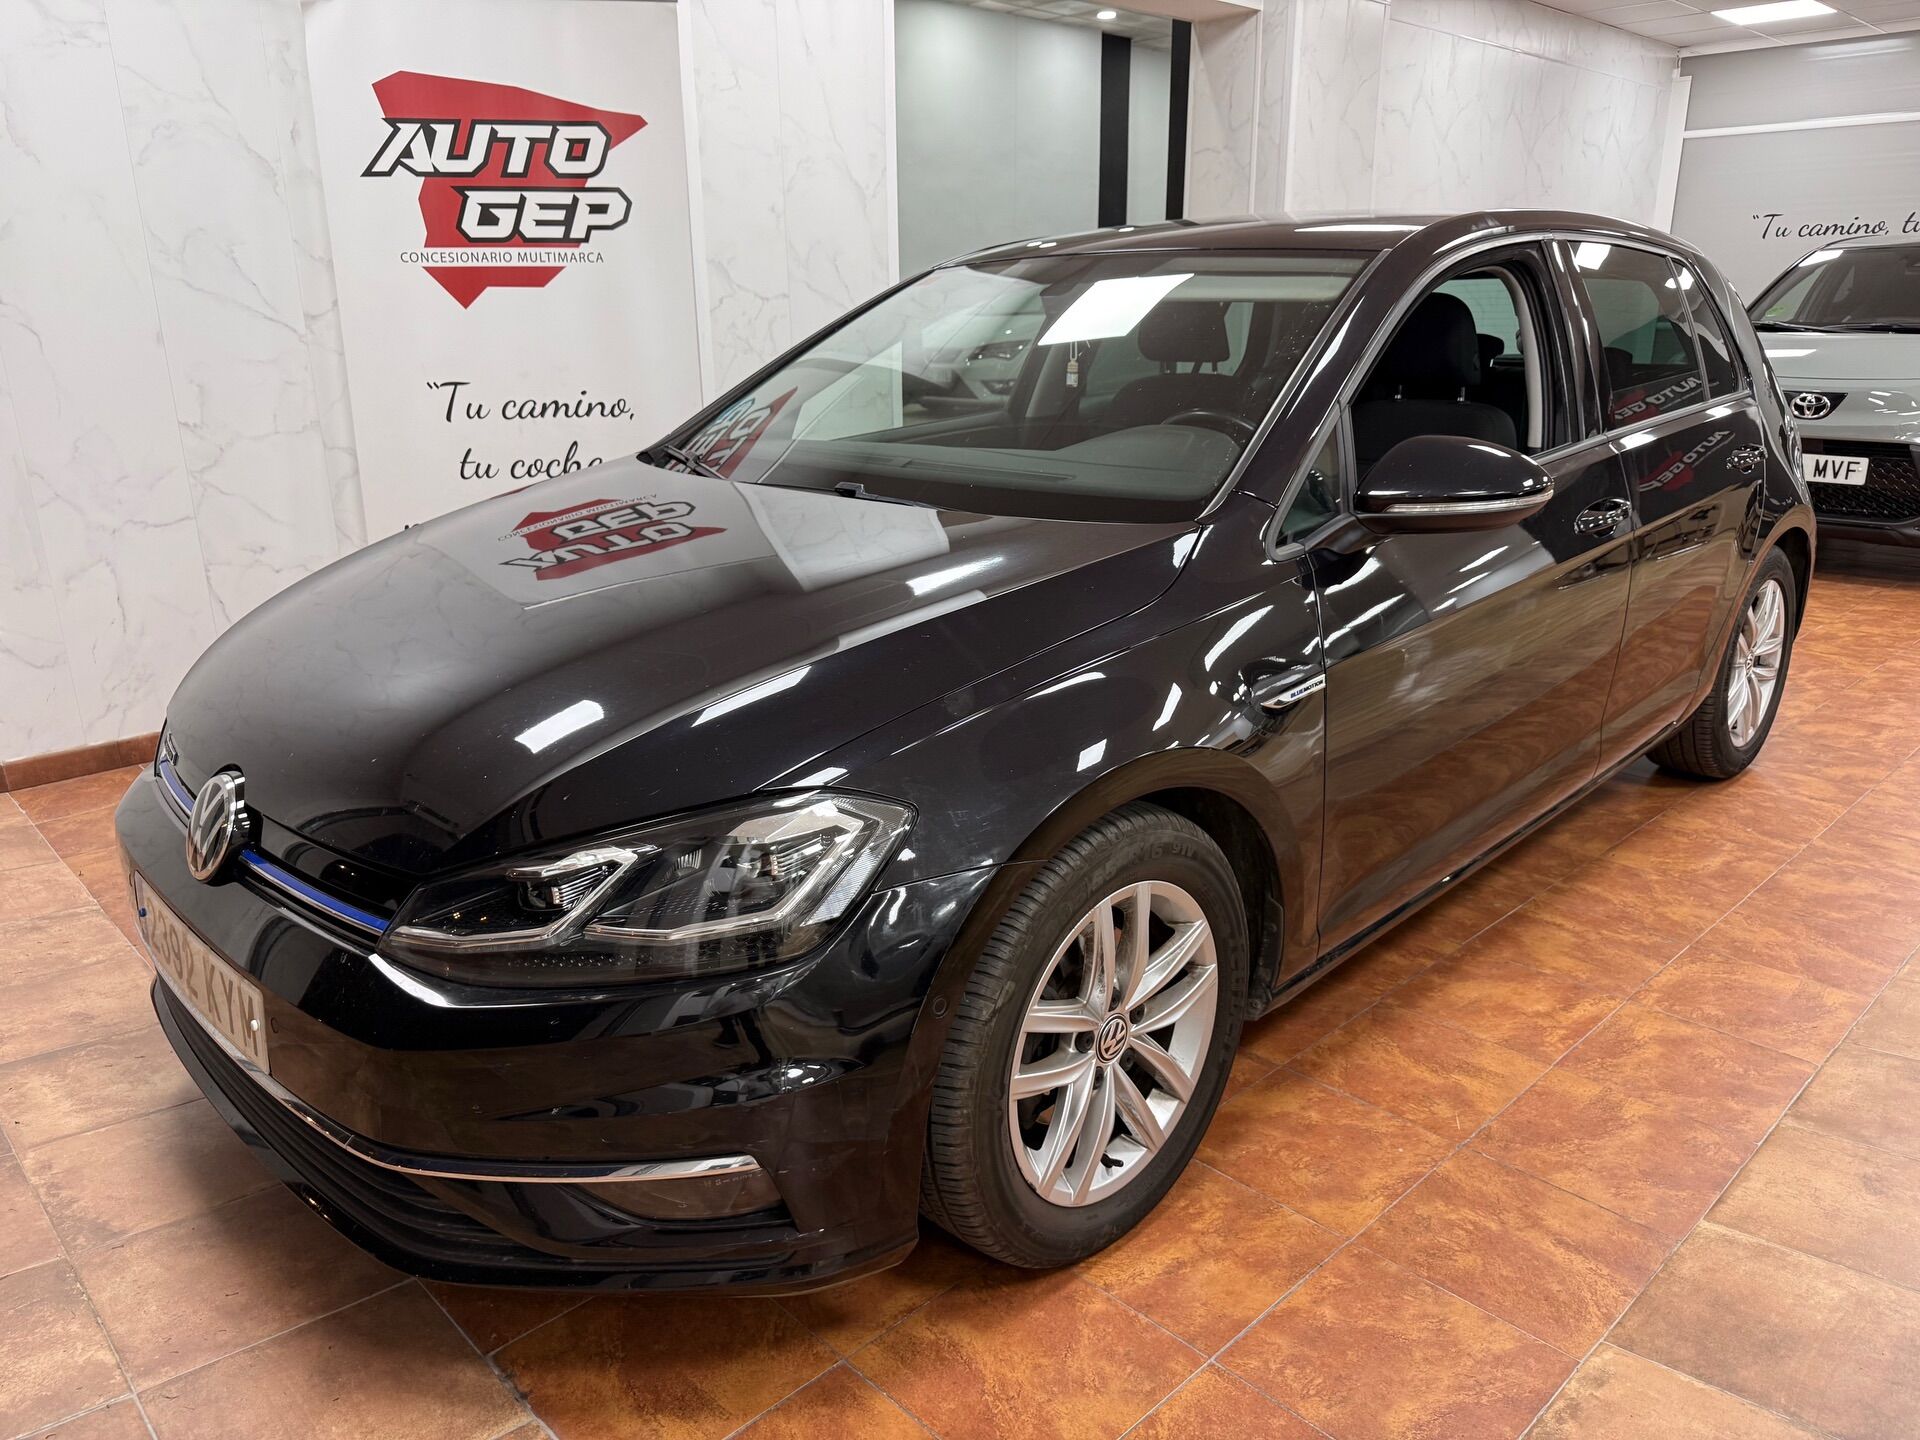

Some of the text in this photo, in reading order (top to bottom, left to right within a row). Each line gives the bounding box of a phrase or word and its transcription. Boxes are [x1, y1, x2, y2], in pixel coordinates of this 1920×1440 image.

[361, 119, 611, 178] AUTO
[452, 188, 631, 242] GEP
[1798, 216, 1889, 237] camino,
[400, 251, 604, 263] CONCESIONARIO MULTIMARCA
[501, 390, 635, 421] camino,
[459, 448, 500, 479] tu
[1813, 458, 1860, 480] MVF
[147, 897, 258, 1057] 2392 KYM
